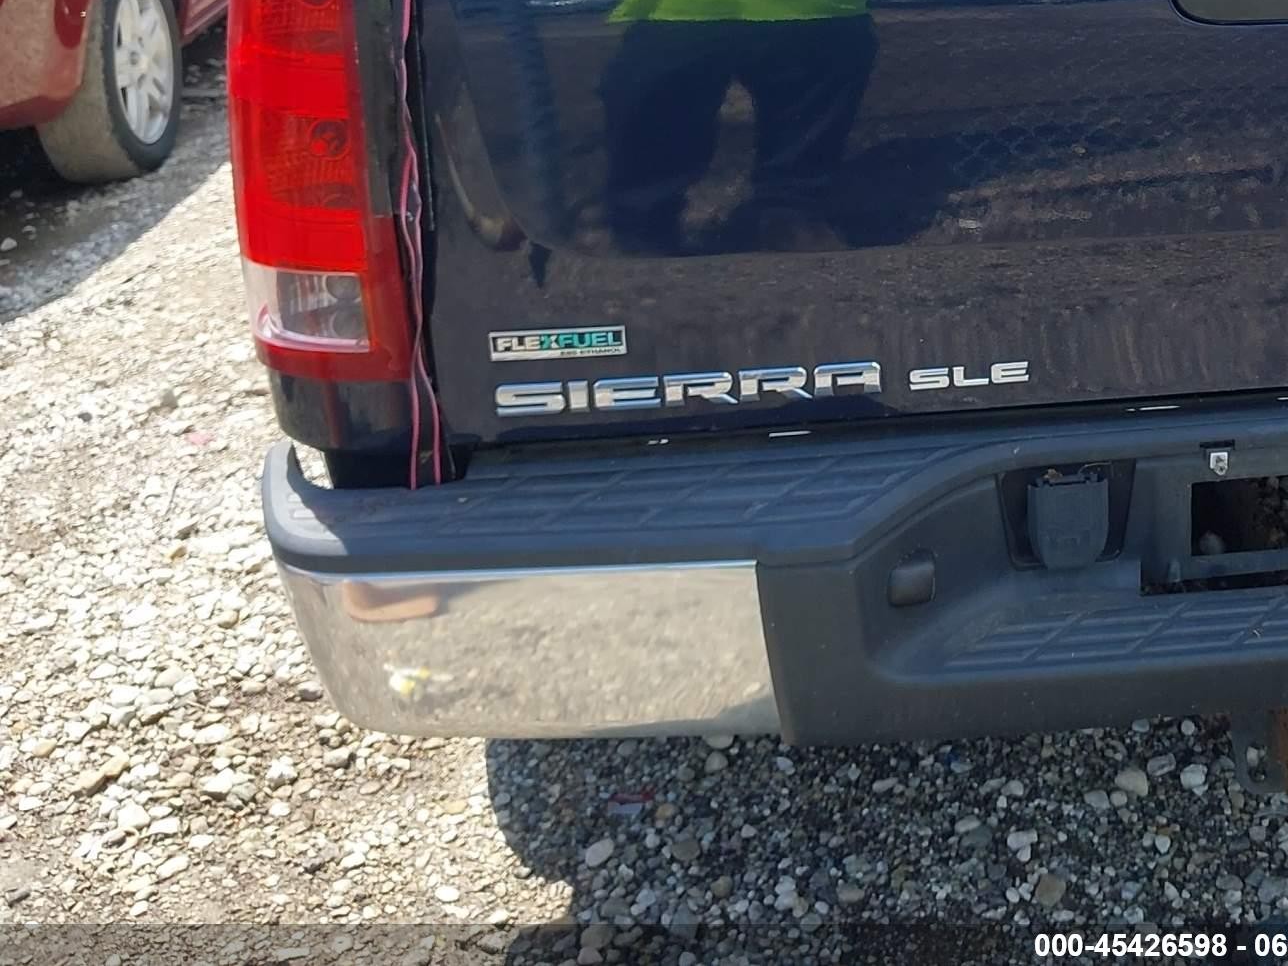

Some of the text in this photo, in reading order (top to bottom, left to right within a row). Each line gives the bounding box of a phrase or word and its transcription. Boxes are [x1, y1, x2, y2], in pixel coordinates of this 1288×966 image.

[496, 332, 622, 352] FLEXFUEL
[495, 361, 1030, 416] SIERRA SLE
